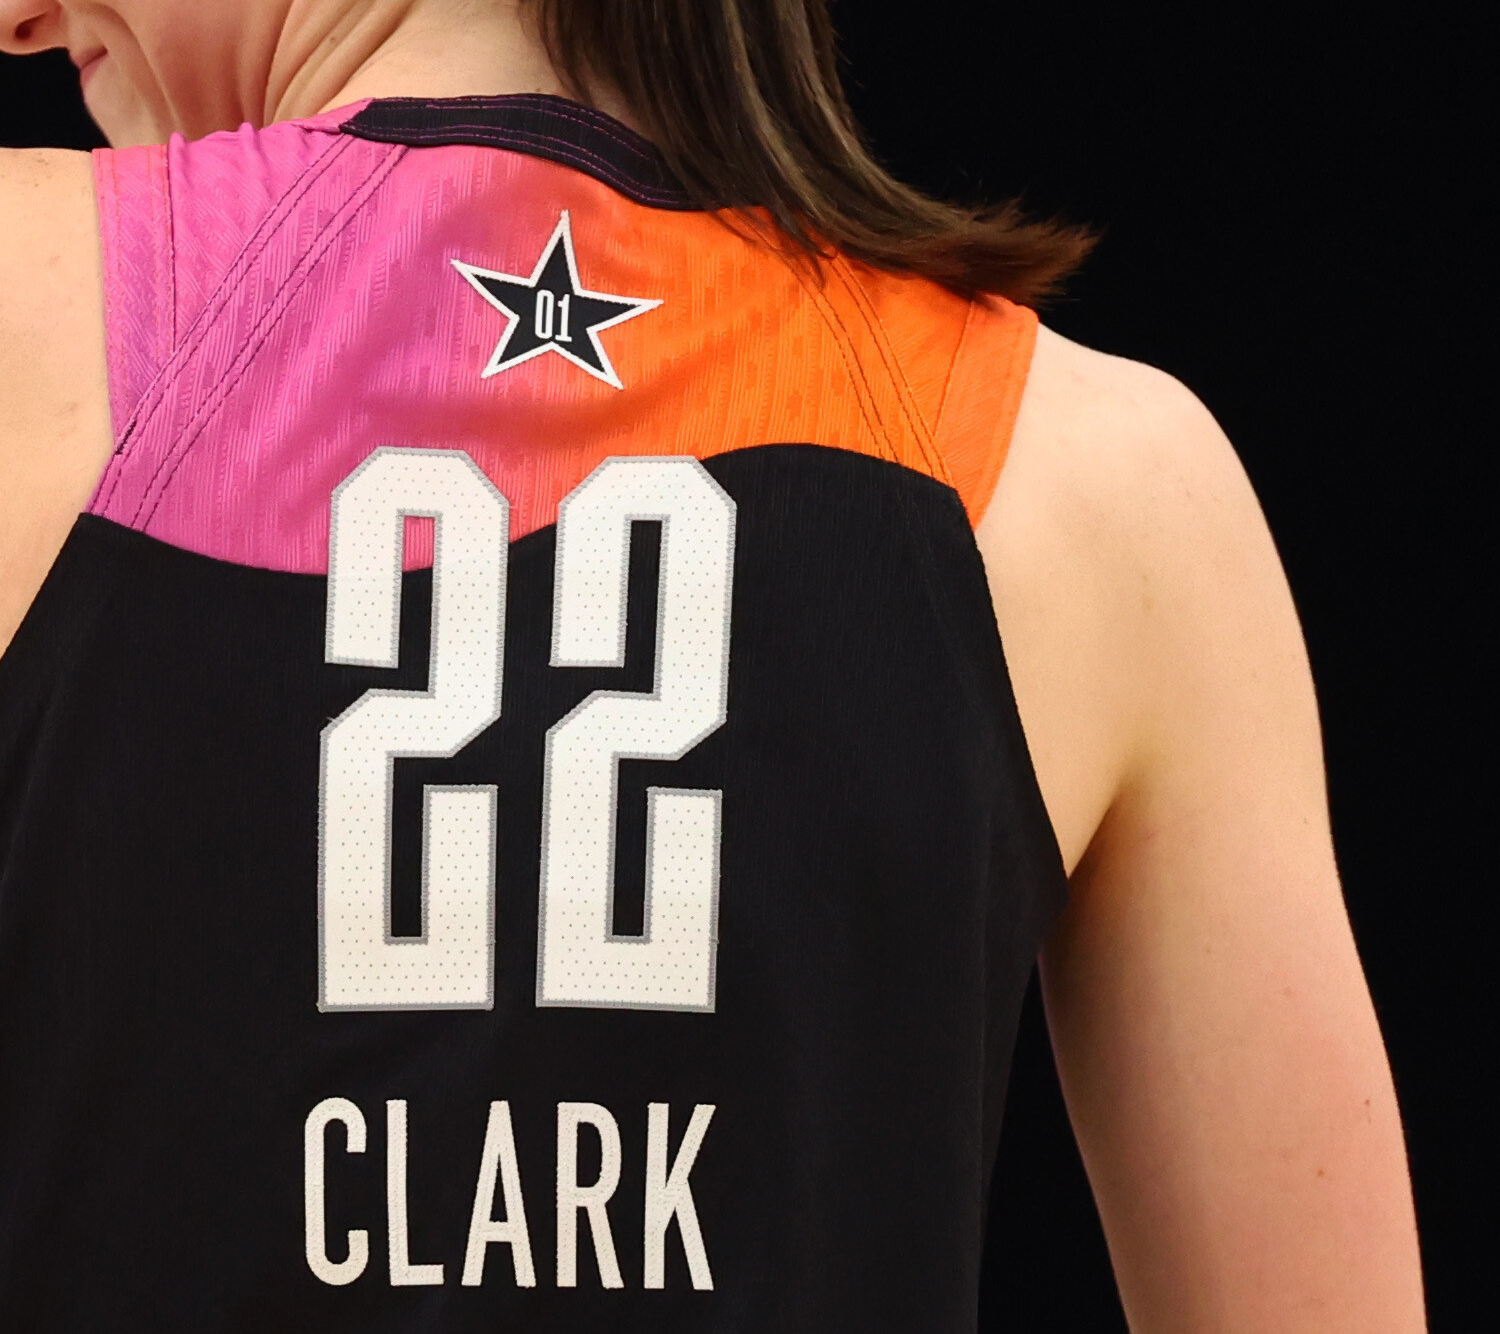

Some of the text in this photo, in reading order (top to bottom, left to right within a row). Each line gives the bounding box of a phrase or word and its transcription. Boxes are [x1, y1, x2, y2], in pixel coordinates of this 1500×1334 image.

[535, 289, 573, 343] 01
[318, 446, 737, 1014] 22
[304, 1097, 716, 1291] CLARK
